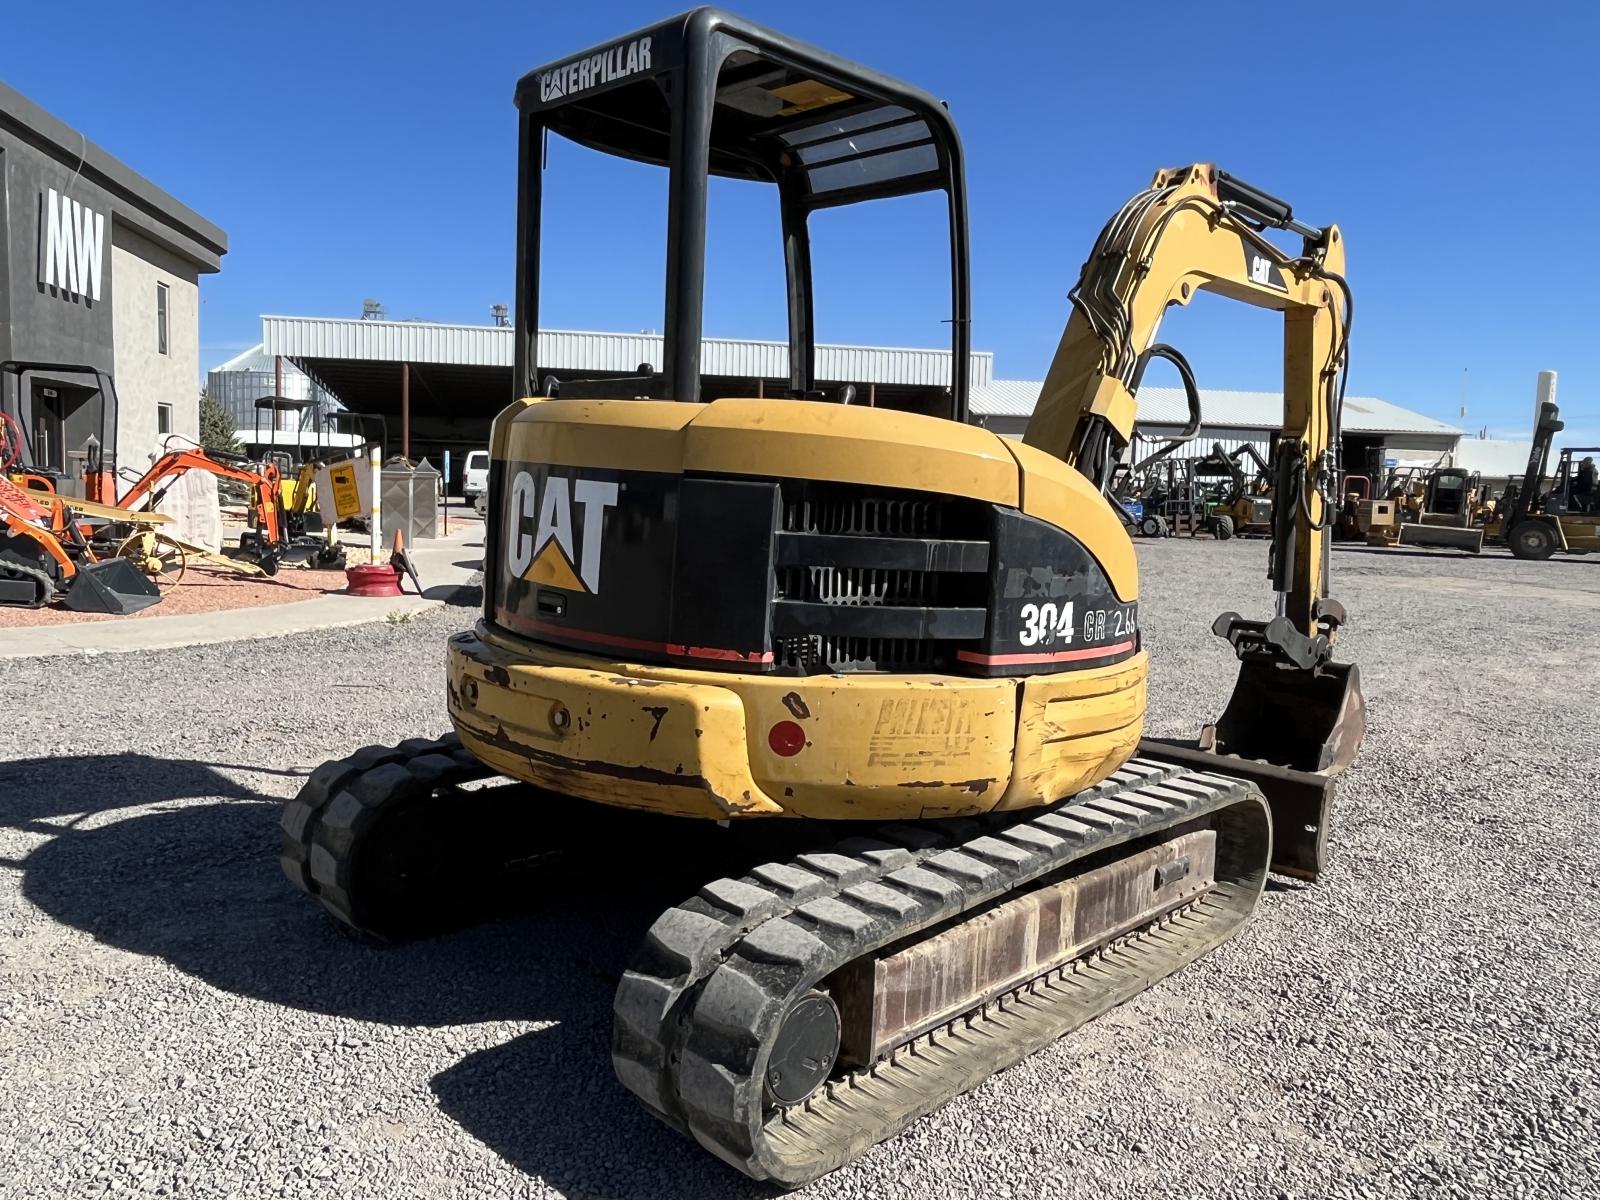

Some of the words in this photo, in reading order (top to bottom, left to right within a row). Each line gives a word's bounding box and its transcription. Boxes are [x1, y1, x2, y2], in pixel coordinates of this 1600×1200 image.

[540, 36, 652, 102] CATERPILLAR
[45, 187, 104, 302] MW
[1252, 255, 1272, 285] CAT
[508, 471, 619, 595] CAT
[1019, 601, 1074, 646] 304
[1083, 610, 1106, 642] CR
